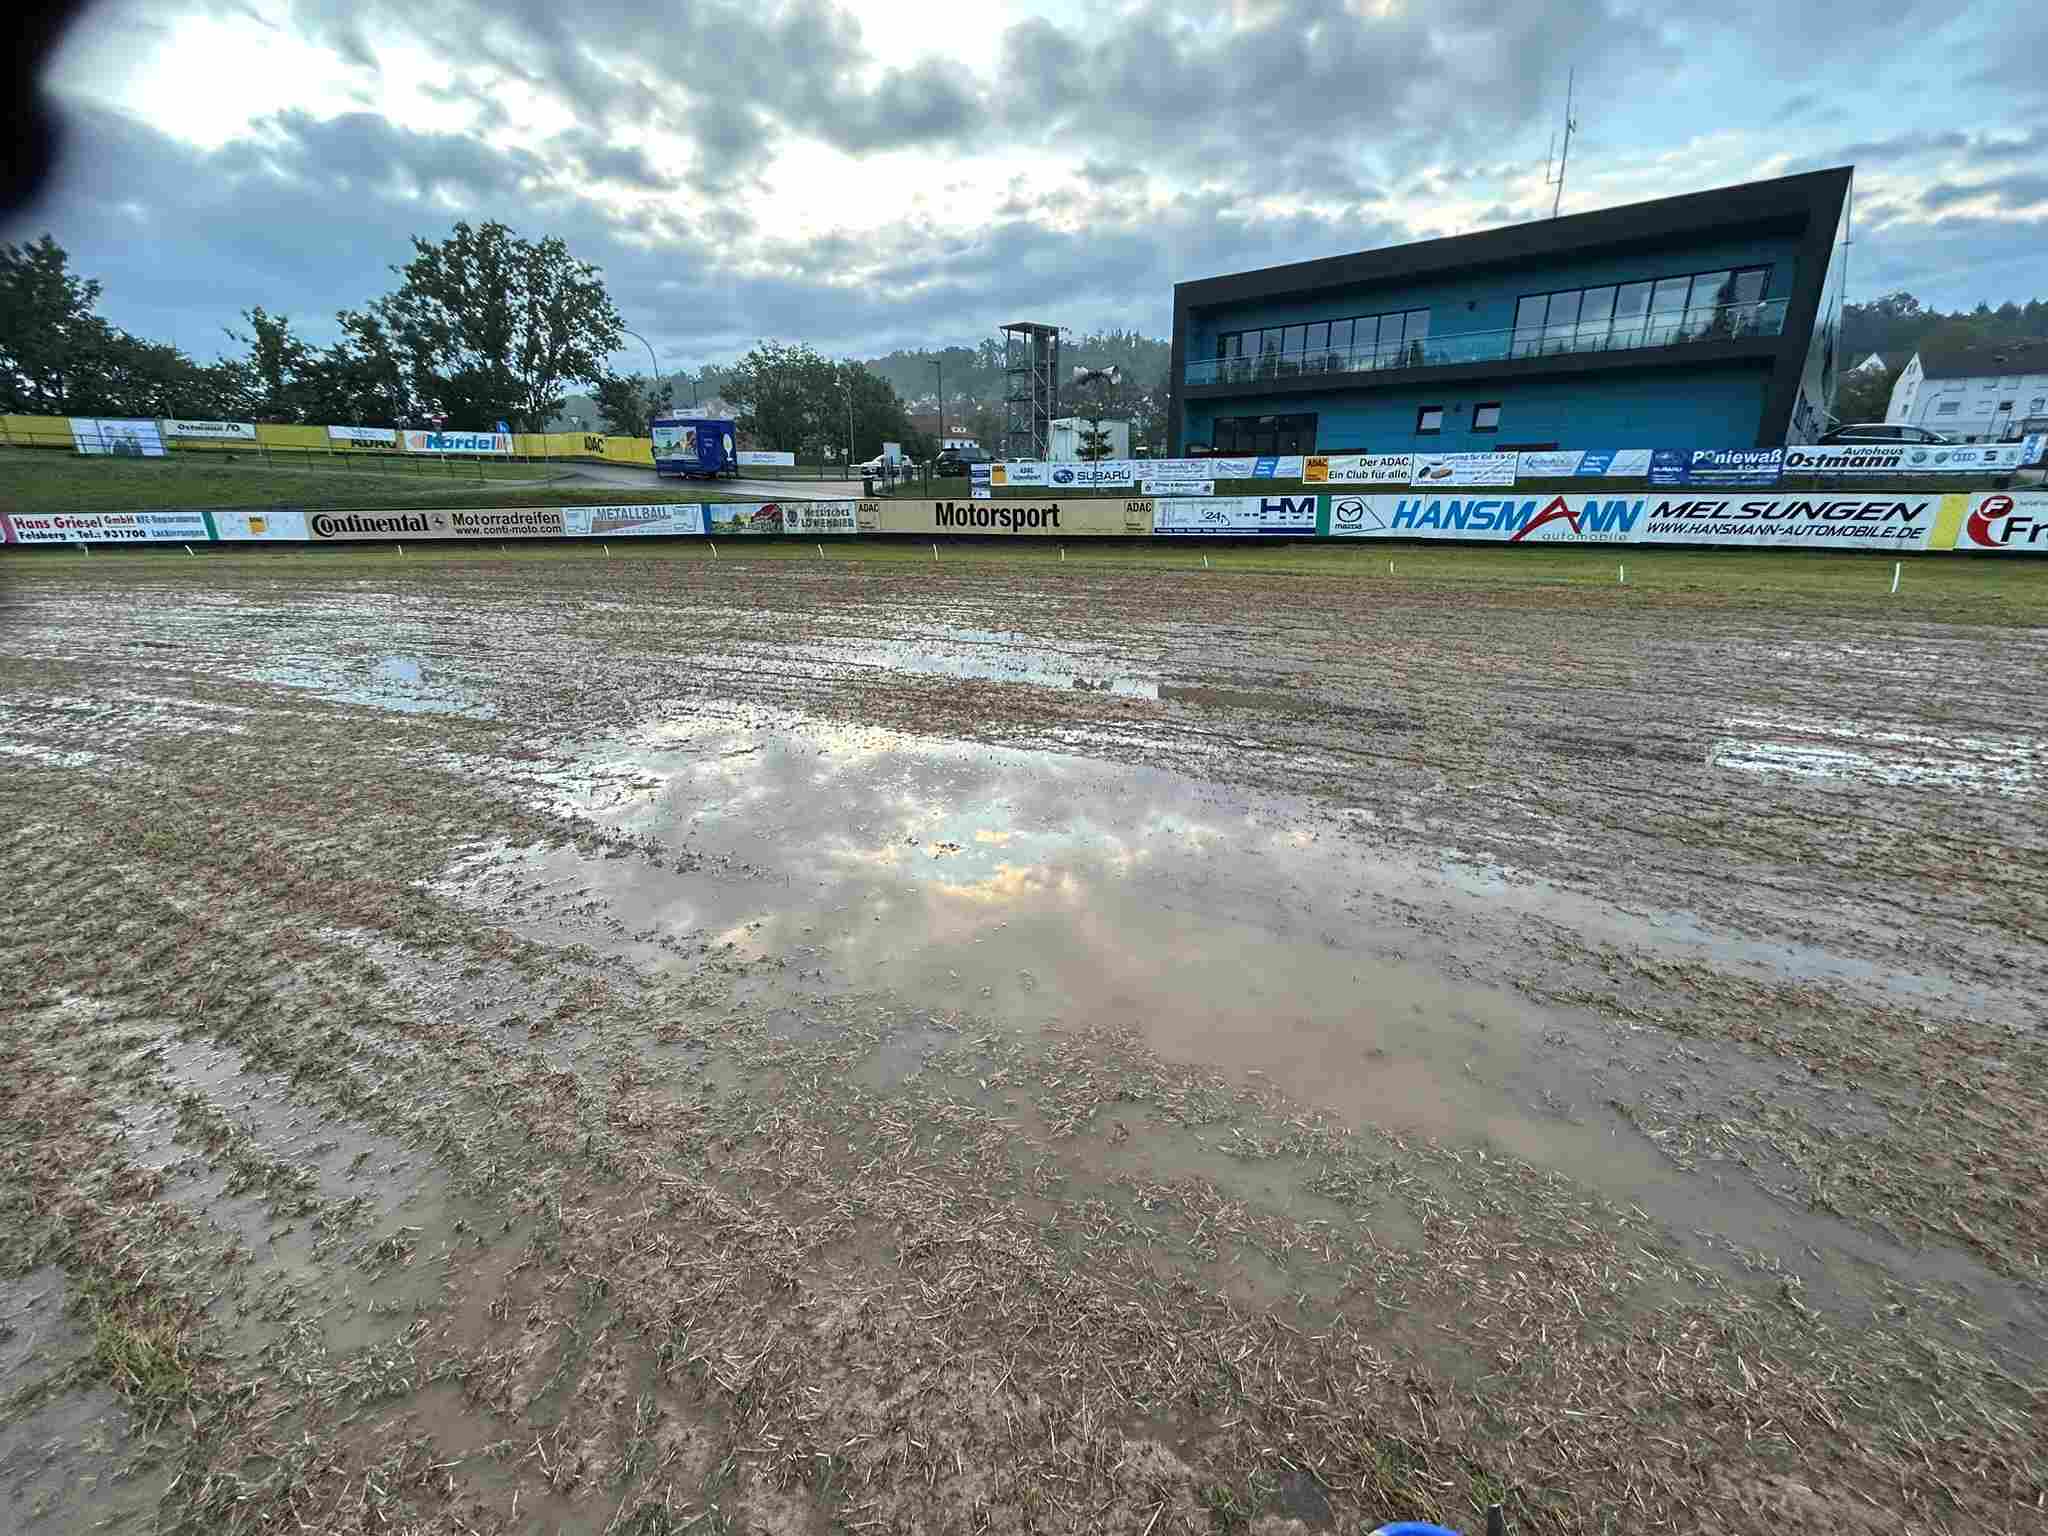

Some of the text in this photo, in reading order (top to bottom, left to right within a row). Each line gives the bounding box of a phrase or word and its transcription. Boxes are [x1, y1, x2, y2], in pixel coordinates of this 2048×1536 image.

[1843, 447, 1904, 455] Autohaus
[1360, 457, 1412, 467] Der ADAC.
[1787, 452, 1899, 467] Ostmann
[1077, 471, 1132, 481] SUBARU
[1329, 471, 1344, 480] Ein
[1346, 470, 1369, 479] Club
[1388, 469, 1411, 479] alle.
[858, 503, 879, 513] ADAC
[1126, 502, 1152, 513] ADAC
[1260, 497, 1315, 514] HM
[1650, 501, 1928, 521] MELSUNGEN
[451, 512, 561, 526] Motorradreifen
[597, 506, 666, 520] METALLBAU
[935, 502, 1060, 532] Motorsport
[1391, 496, 1644, 541] HANSMANN
[14, 516, 50, 529] Hans
[54, 515, 102, 529] Griesel
[311, 513, 430, 537] Continental
[20, 531, 66, 540] Felsberg
[104, 530, 146, 538] 931700
[455, 526, 562, 535] www.conti-moto.com
[1542, 530, 1628, 541] automobile
[1647, 522, 1926, 539] WWW.HANSMANN-AUTOMOBILE.DE
